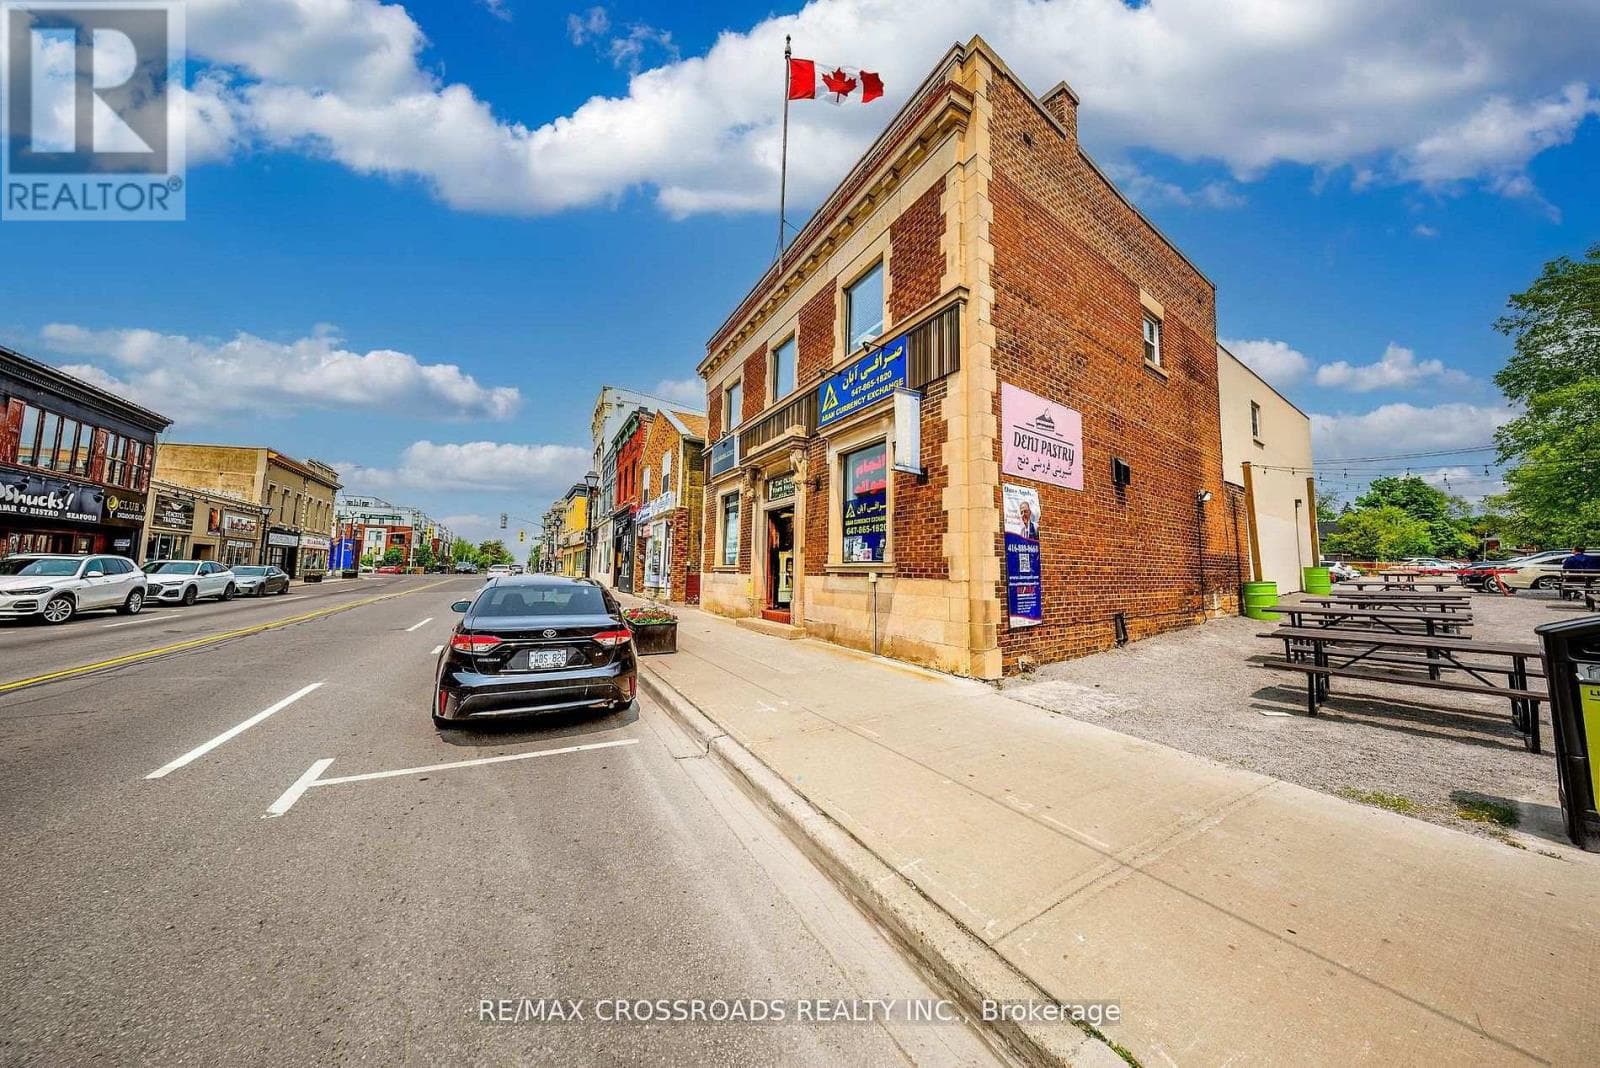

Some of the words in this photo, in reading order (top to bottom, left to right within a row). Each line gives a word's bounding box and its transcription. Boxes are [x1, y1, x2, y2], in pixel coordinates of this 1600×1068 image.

[835, 396, 866, 415] CURRENCY
[867, 377, 904, 401] EXCHANGE
[1041, 440, 1075, 466] PASTRY
[30, 508, 59, 517] BISTRO
[66, 512, 97, 521] SEAFOOD
[118, 500, 140, 513] CLUB
